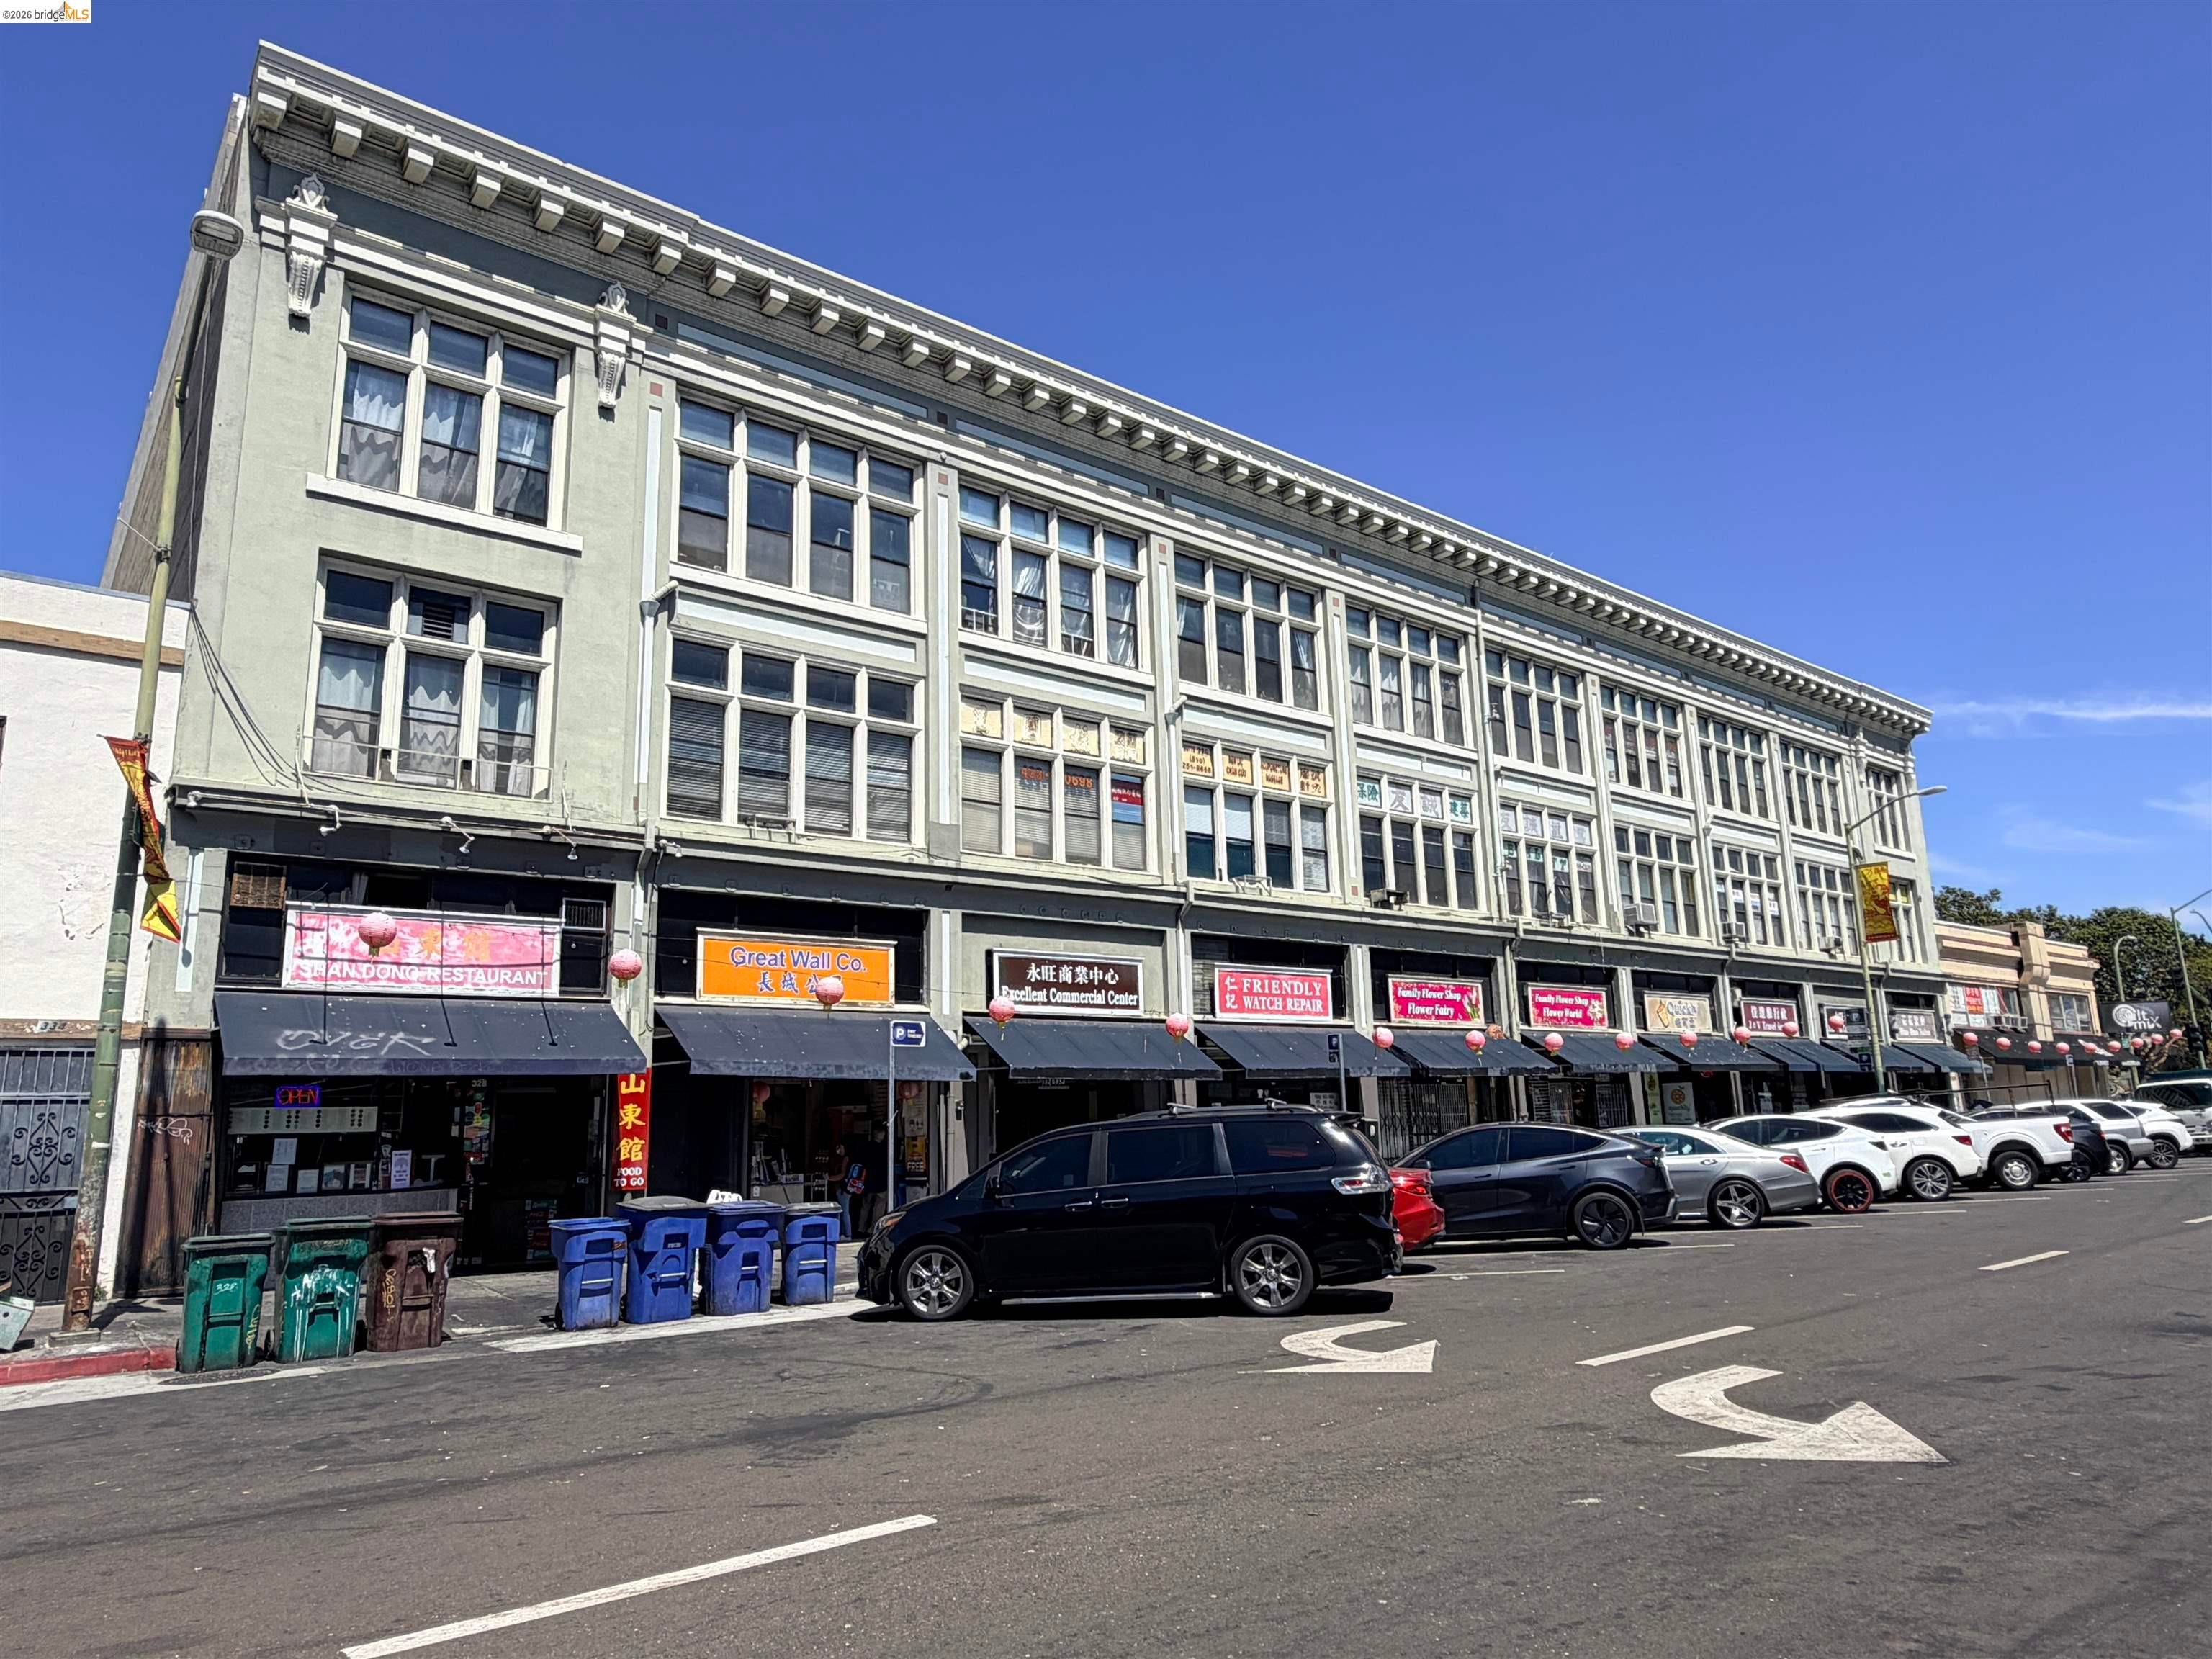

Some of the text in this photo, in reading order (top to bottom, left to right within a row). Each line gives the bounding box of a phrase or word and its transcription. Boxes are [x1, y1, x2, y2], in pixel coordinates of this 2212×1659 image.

[730, 946, 868, 971] Great Wall Co.
[298, 963, 548, 986] SHAN DONG RESTAURANT
[758, 971, 841, 994] 長城公
[1026, 963, 1119, 985] 永旺商業中心
[1242, 978, 1322, 996] FRIENDLY
[1398, 986, 1462, 1002] Family Flower Shop
[1001, 986, 1138, 1006] Excellent Commercial Center
[1243, 995, 1323, 1012] WATCH REPAIR
[1535, 994, 1555, 1005] Family
[1575, 996, 1588, 1007] Shop
[1408, 1002, 1455, 1019] Flower Fairy
[278, 1088, 319, 1105] OPEN
[619, 1073, 646, 1162] 山東館
[617, 1166, 642, 1177] FOOD
[614, 1177, 644, 1187] TO GO
